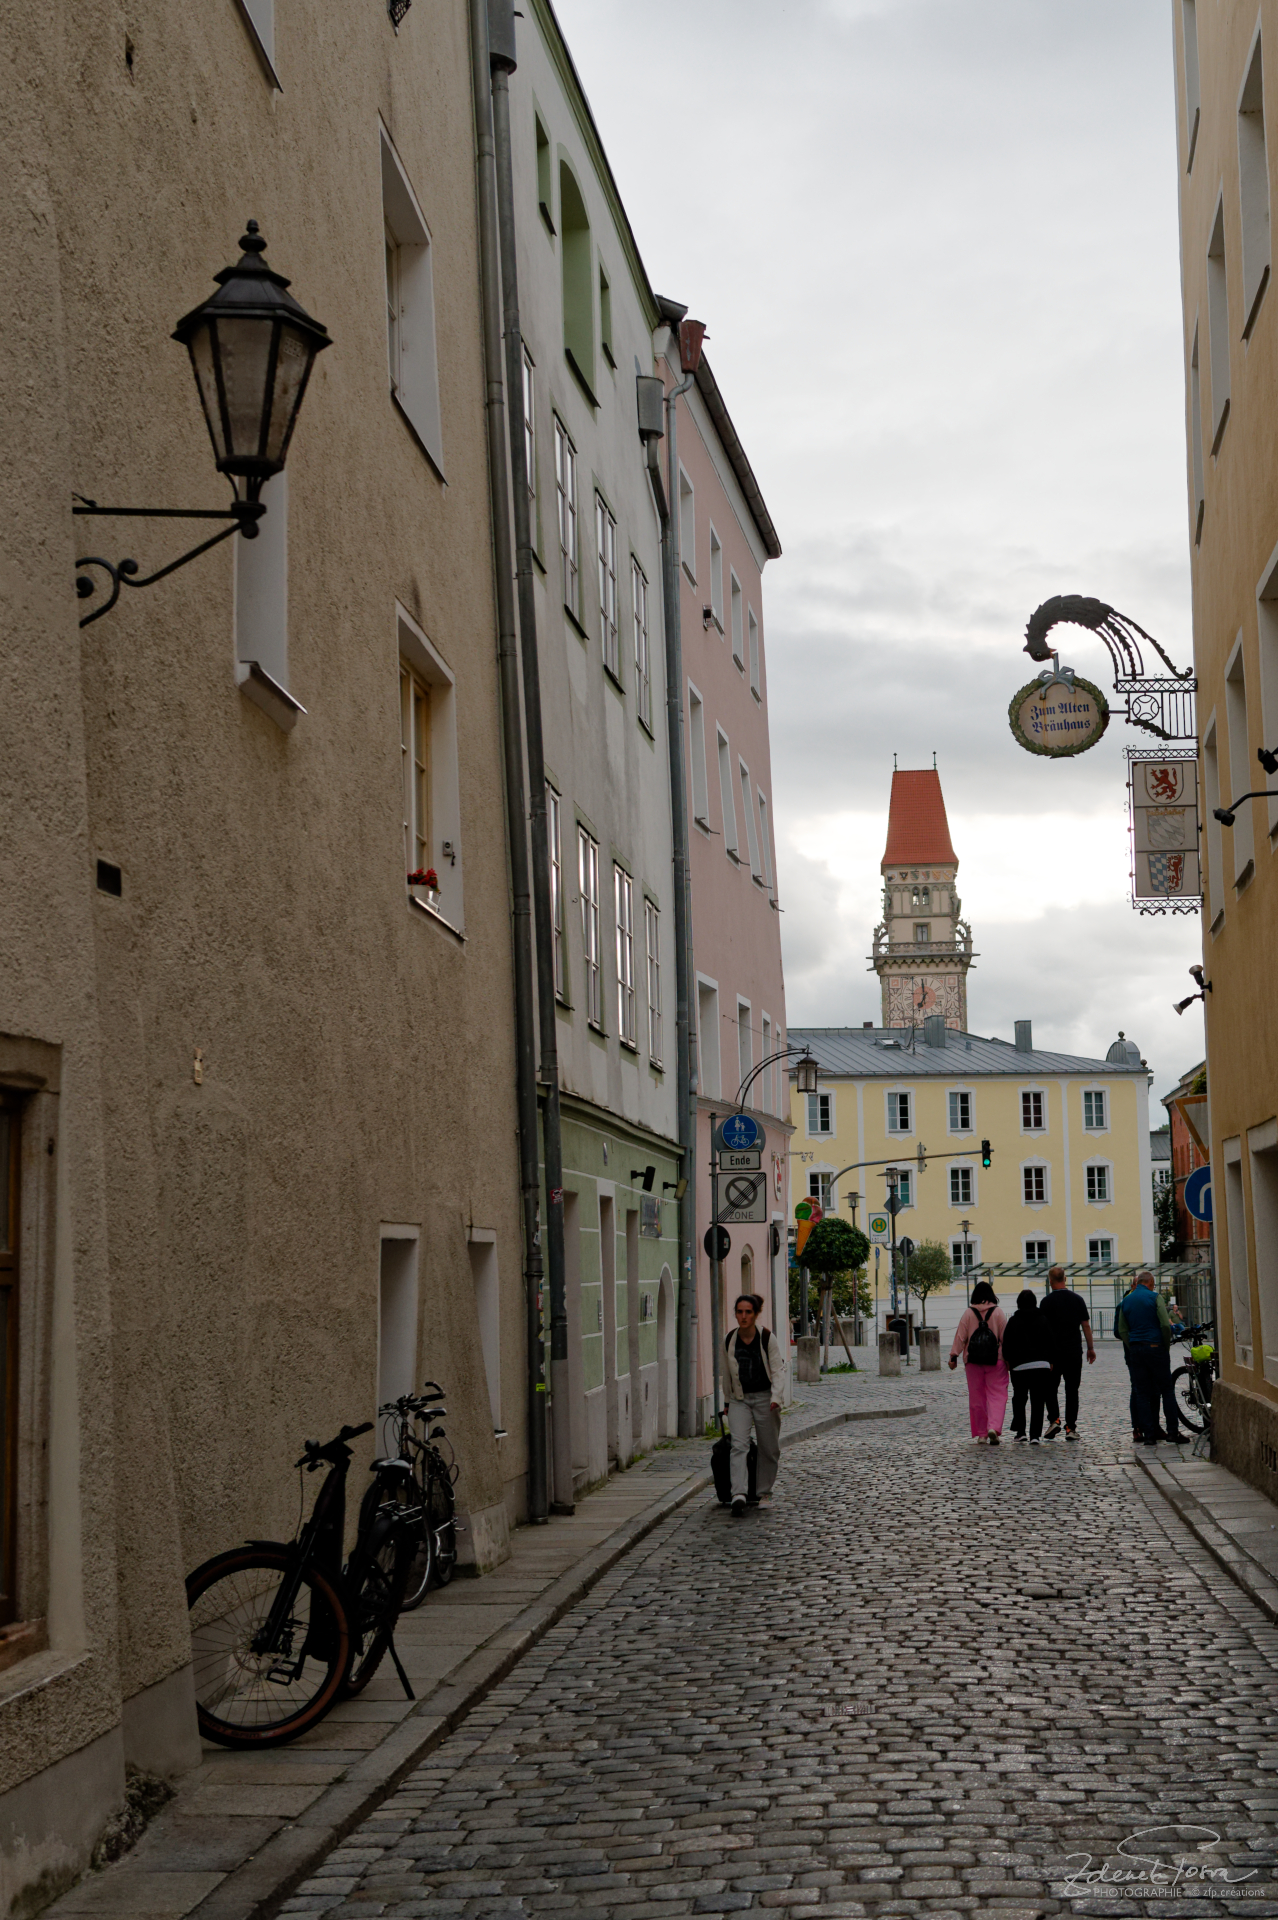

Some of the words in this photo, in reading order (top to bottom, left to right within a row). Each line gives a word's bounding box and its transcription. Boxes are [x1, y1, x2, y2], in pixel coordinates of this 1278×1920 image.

[1030, 705, 1056, 721] Zum
[1057, 702, 1090, 714] Alten
[1032, 718, 1091, 733] Bräuhaus
[730, 1155, 751, 1166] Ende
[729, 1211, 754, 1220] ZONE
[875, 1221, 883, 1230] H
